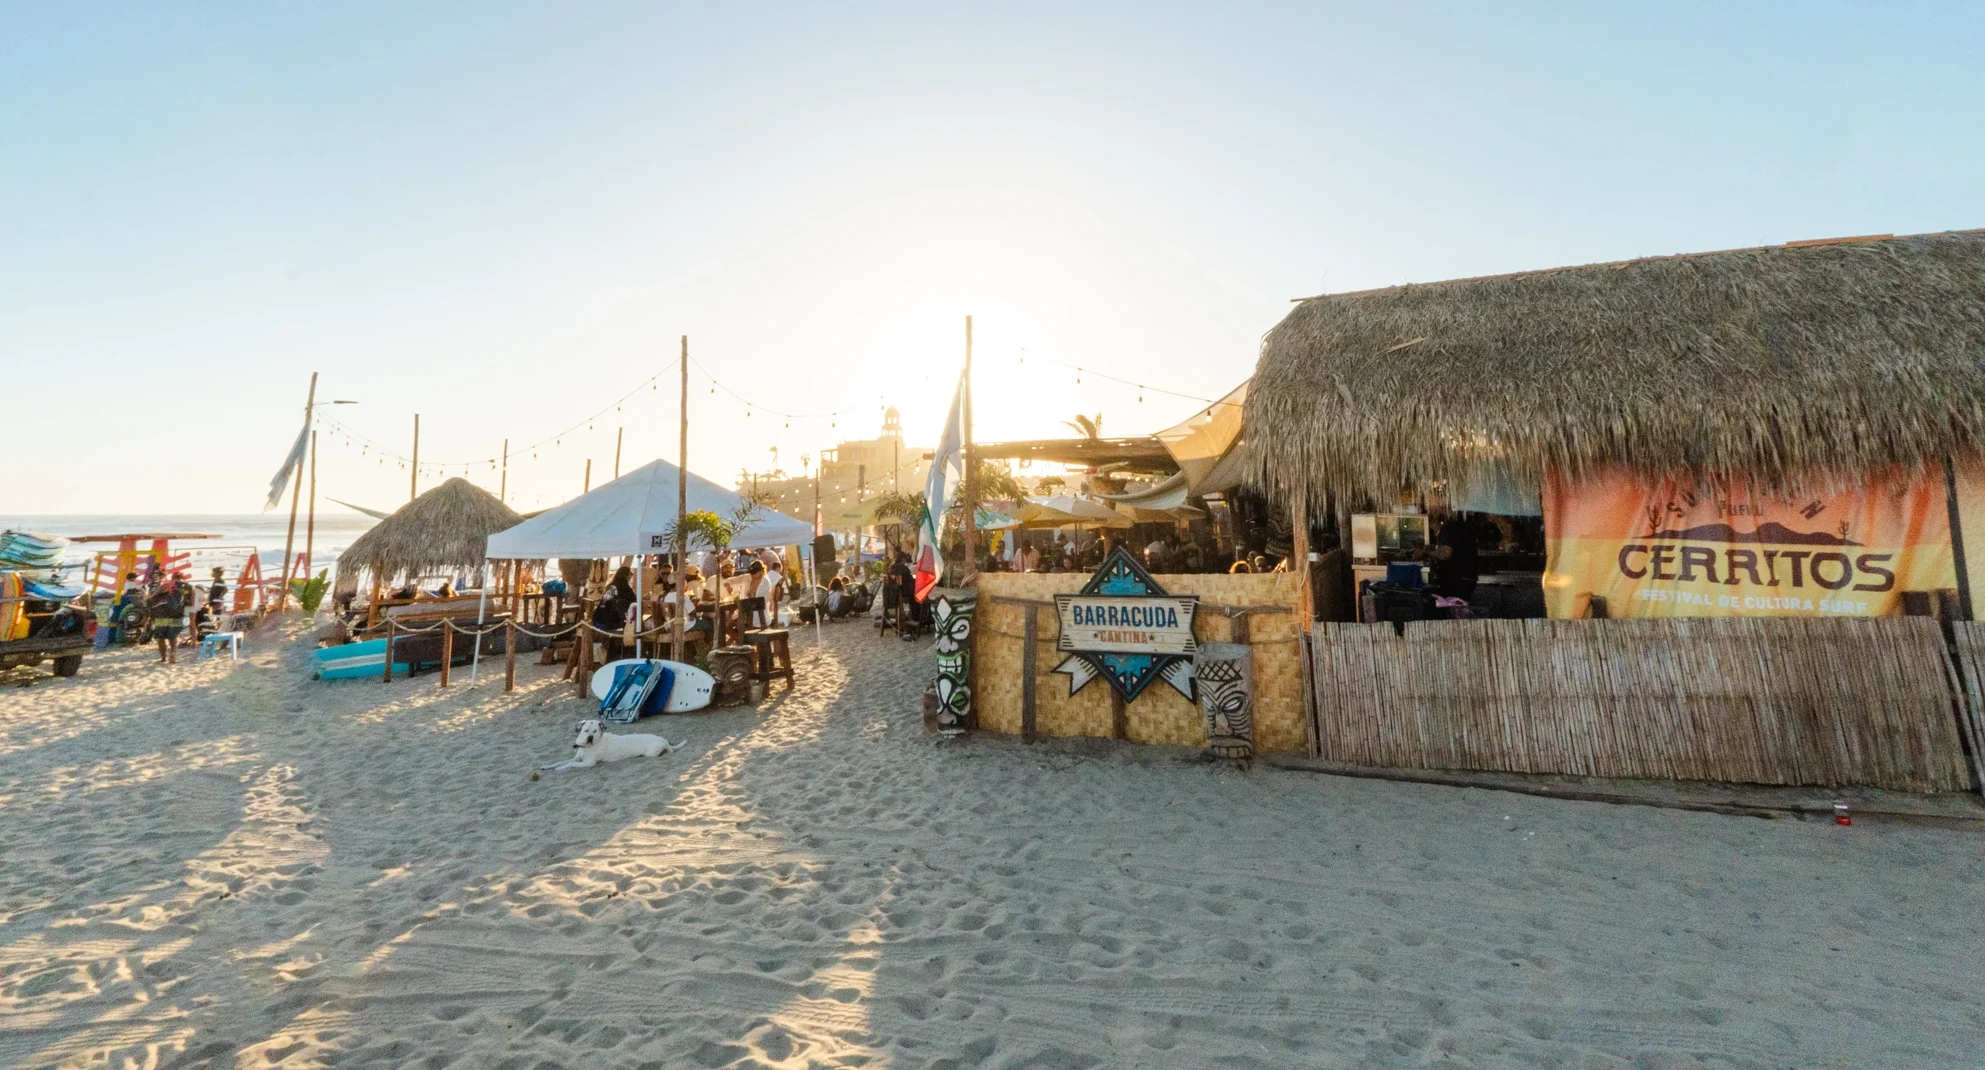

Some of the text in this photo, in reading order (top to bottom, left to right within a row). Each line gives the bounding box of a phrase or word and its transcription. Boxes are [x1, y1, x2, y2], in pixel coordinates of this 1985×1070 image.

[1618, 544, 1895, 592] CERRITOS
[1641, 589, 1869, 615] FESTIVAL DE CULTURA SURF
[1073, 605, 1179, 628] BARRACUDA
[1100, 630, 1149, 644] CANTINA
